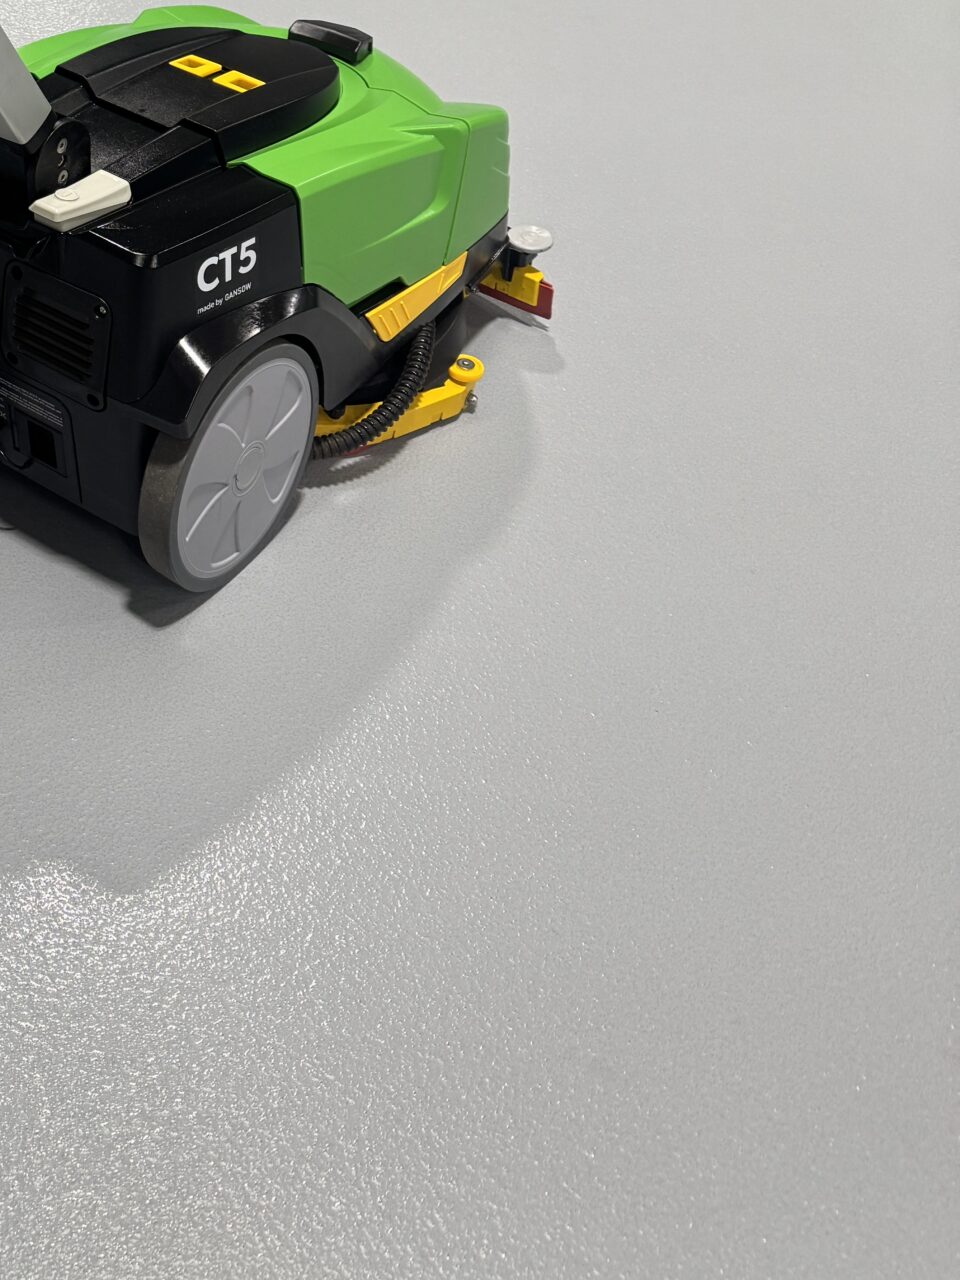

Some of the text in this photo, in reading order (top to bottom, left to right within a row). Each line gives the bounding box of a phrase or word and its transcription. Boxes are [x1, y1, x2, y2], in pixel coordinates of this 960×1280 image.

[196, 236, 257, 292] CT5
[197, 281, 252, 315] made by GANSOW
